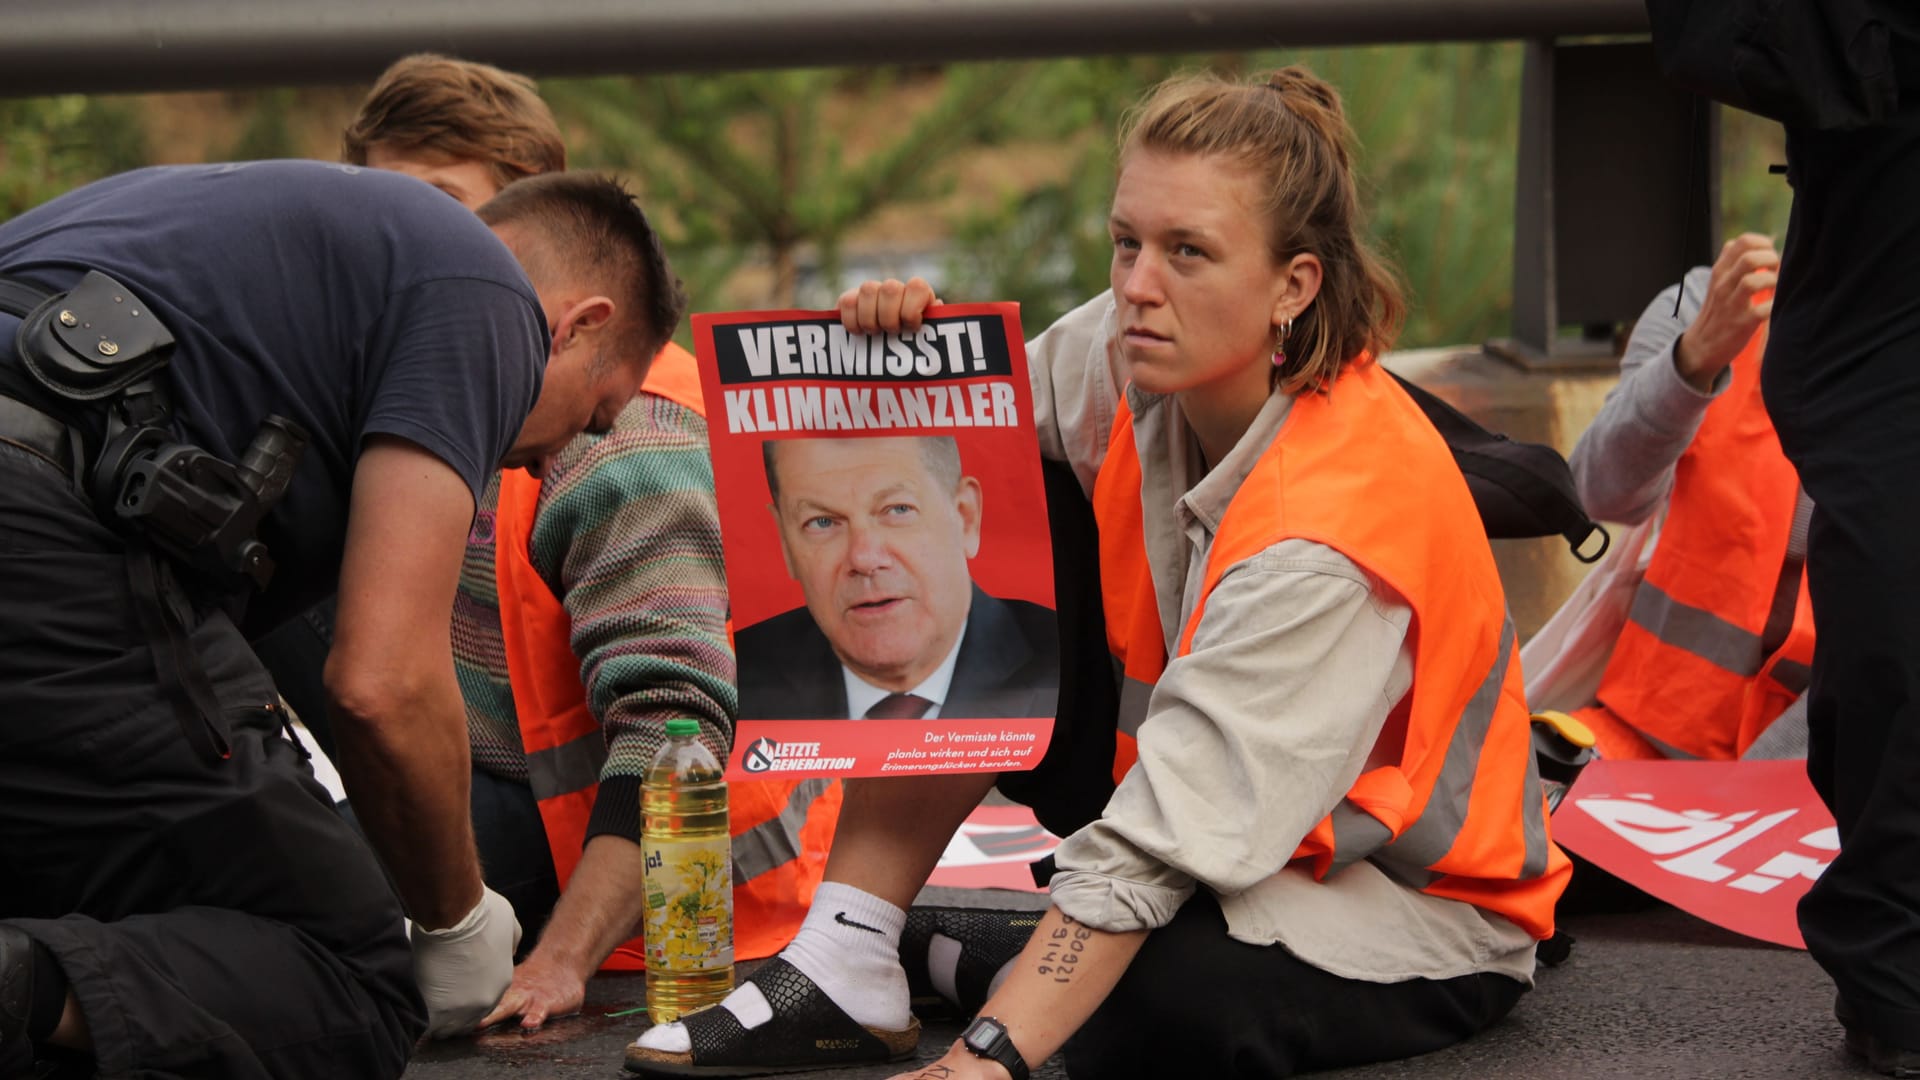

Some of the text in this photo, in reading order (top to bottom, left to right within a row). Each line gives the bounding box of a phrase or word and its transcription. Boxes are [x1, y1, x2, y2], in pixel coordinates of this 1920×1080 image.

[738, 320, 987, 377] VERMISST!
[724, 382, 1019, 434] KLIMAKANZLER
[924, 730, 1036, 743] Der Vermisste könnte
[774, 742, 821, 758] LETZTE
[887, 746, 1033, 761] planlos wirken und sich auf
[769, 757, 857, 771] GENERATION
[881, 759, 1023, 772] Erinnerungslücken berufen.
[644, 850, 663, 877] ja!
